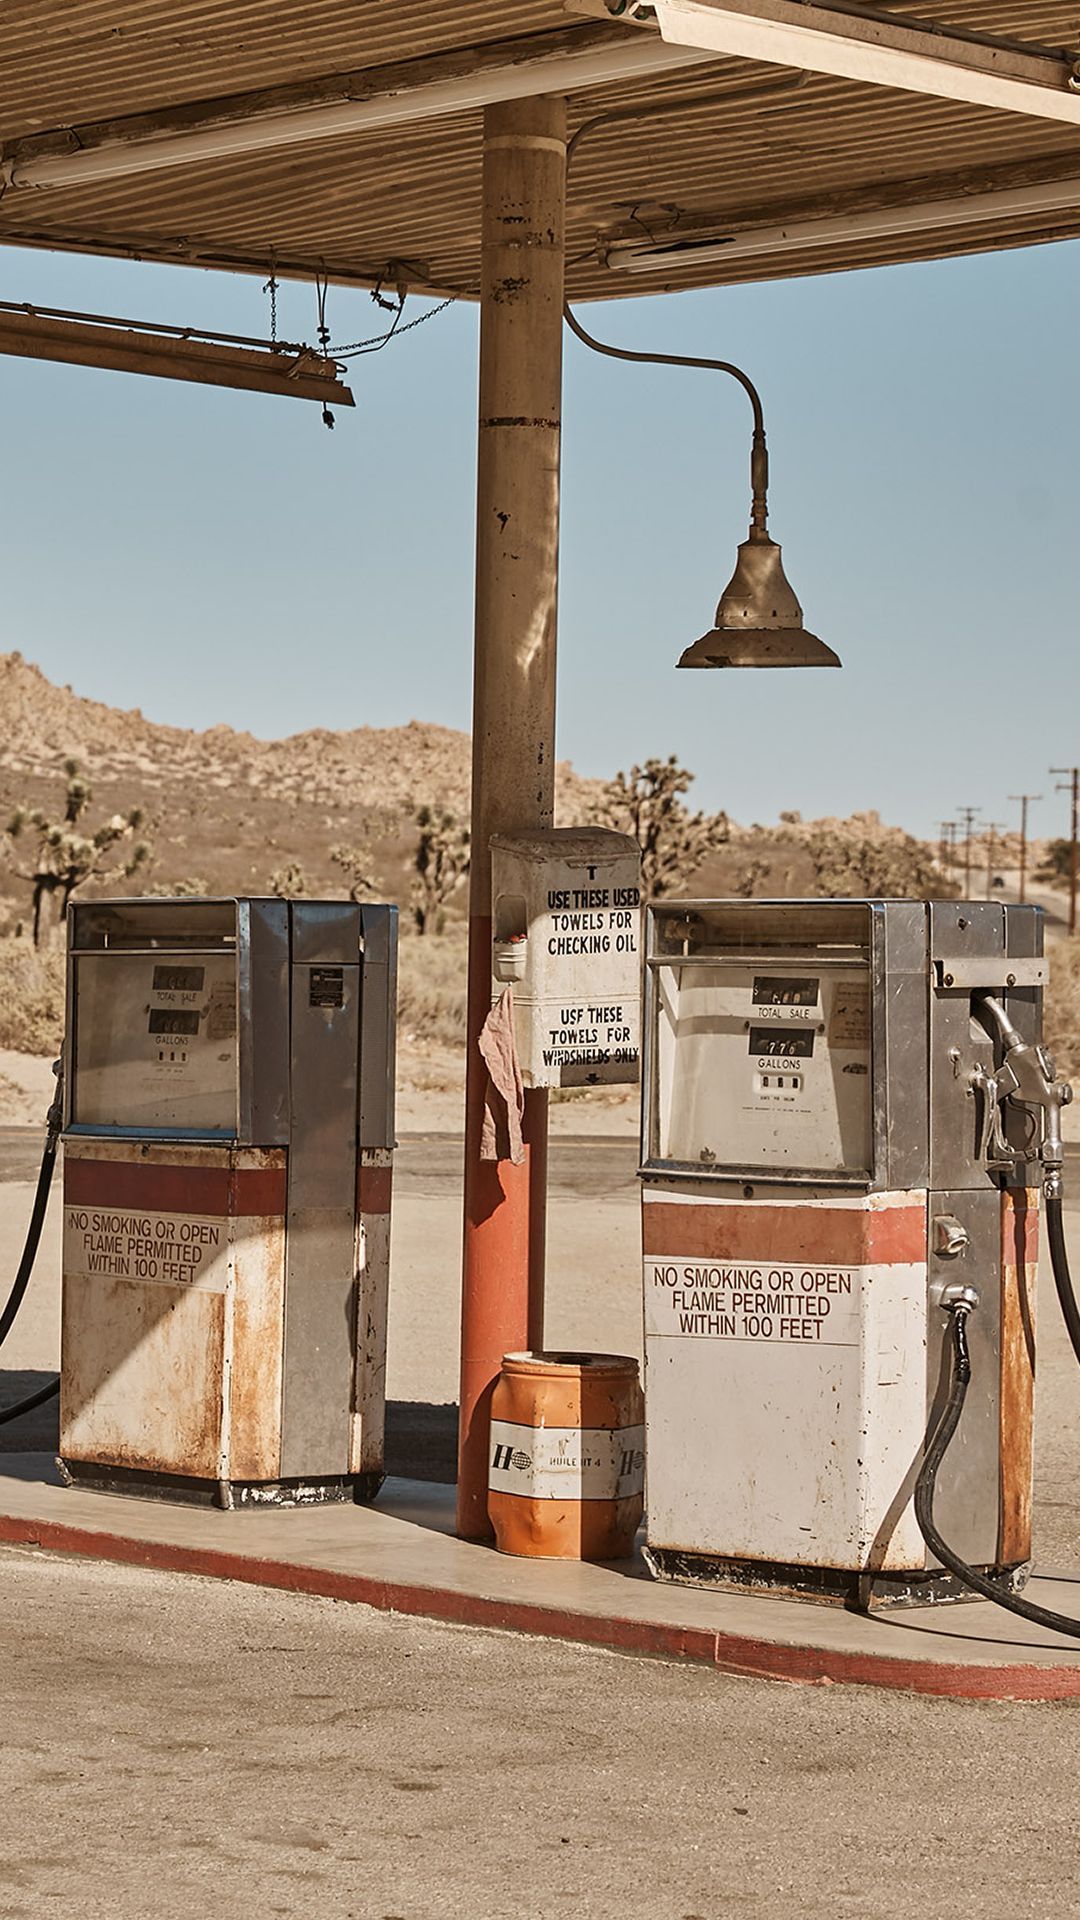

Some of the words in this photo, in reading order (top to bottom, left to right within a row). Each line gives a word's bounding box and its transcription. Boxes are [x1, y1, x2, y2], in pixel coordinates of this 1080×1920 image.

[548, 890, 570, 909] USE
[572, 889, 609, 909] THESE
[613, 887, 640, 907] USED
[551, 913, 604, 931] TOWELS
[609, 912, 632, 929] FOR
[548, 935, 611, 956] CHECKING
[616, 934, 637, 953] OIL
[587, 1006, 623, 1024] THESE
[758, 1007, 782, 1019] TOTAL
[789, 1008, 810, 1019] SALE
[155, 1035, 189, 1046] GALLONS
[549, 1028, 598, 1045] TOWELS
[607, 1027, 631, 1043] FOR
[614, 1047, 639, 1064] ONLY
[757, 1058, 801, 1070] GALLONS
[70, 1212, 88, 1230] NO
[92, 1214, 151, 1237] SMOKING
[155, 1220, 175, 1240] OR
[179, 1223, 219, 1245] OPEN
[83, 1233, 123, 1254] FLAME
[127, 1237, 202, 1264] PERMITTED
[87, 1253, 130, 1276] WITHIN
[134, 1258, 158, 1278] 100
[162, 1262, 197, 1283] FEET
[654, 1266, 678, 1288] NO
[683, 1267, 762, 1291] SMOKING
[768, 1270, 794, 1291] OR
[800, 1271, 851, 1294] OPEN
[672, 1290, 726, 1312] FLAME
[732, 1292, 831, 1316] PERMITTED
[679, 1313, 736, 1335] WITHIN
[741, 1316, 773, 1337] 100
[780, 1318, 824, 1340] FEET
